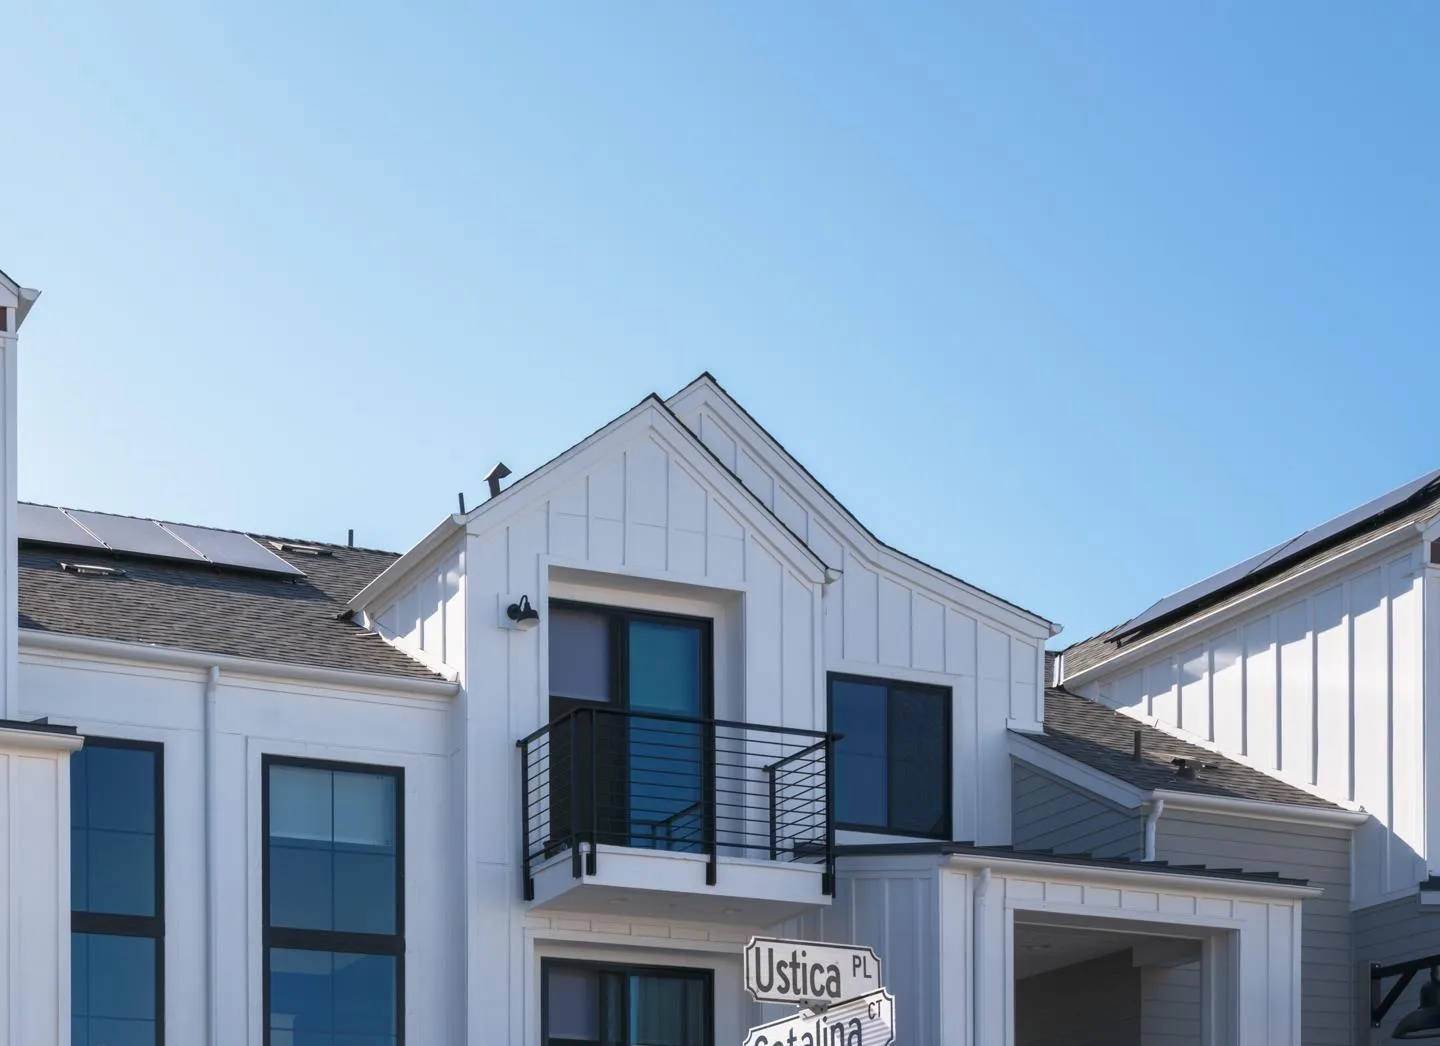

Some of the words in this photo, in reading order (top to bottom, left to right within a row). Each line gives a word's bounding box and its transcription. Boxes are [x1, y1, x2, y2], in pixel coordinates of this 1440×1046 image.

[755, 946, 841, 998] Ustica
[852, 955, 872, 979] PL
[868, 999, 883, 1020] CT
